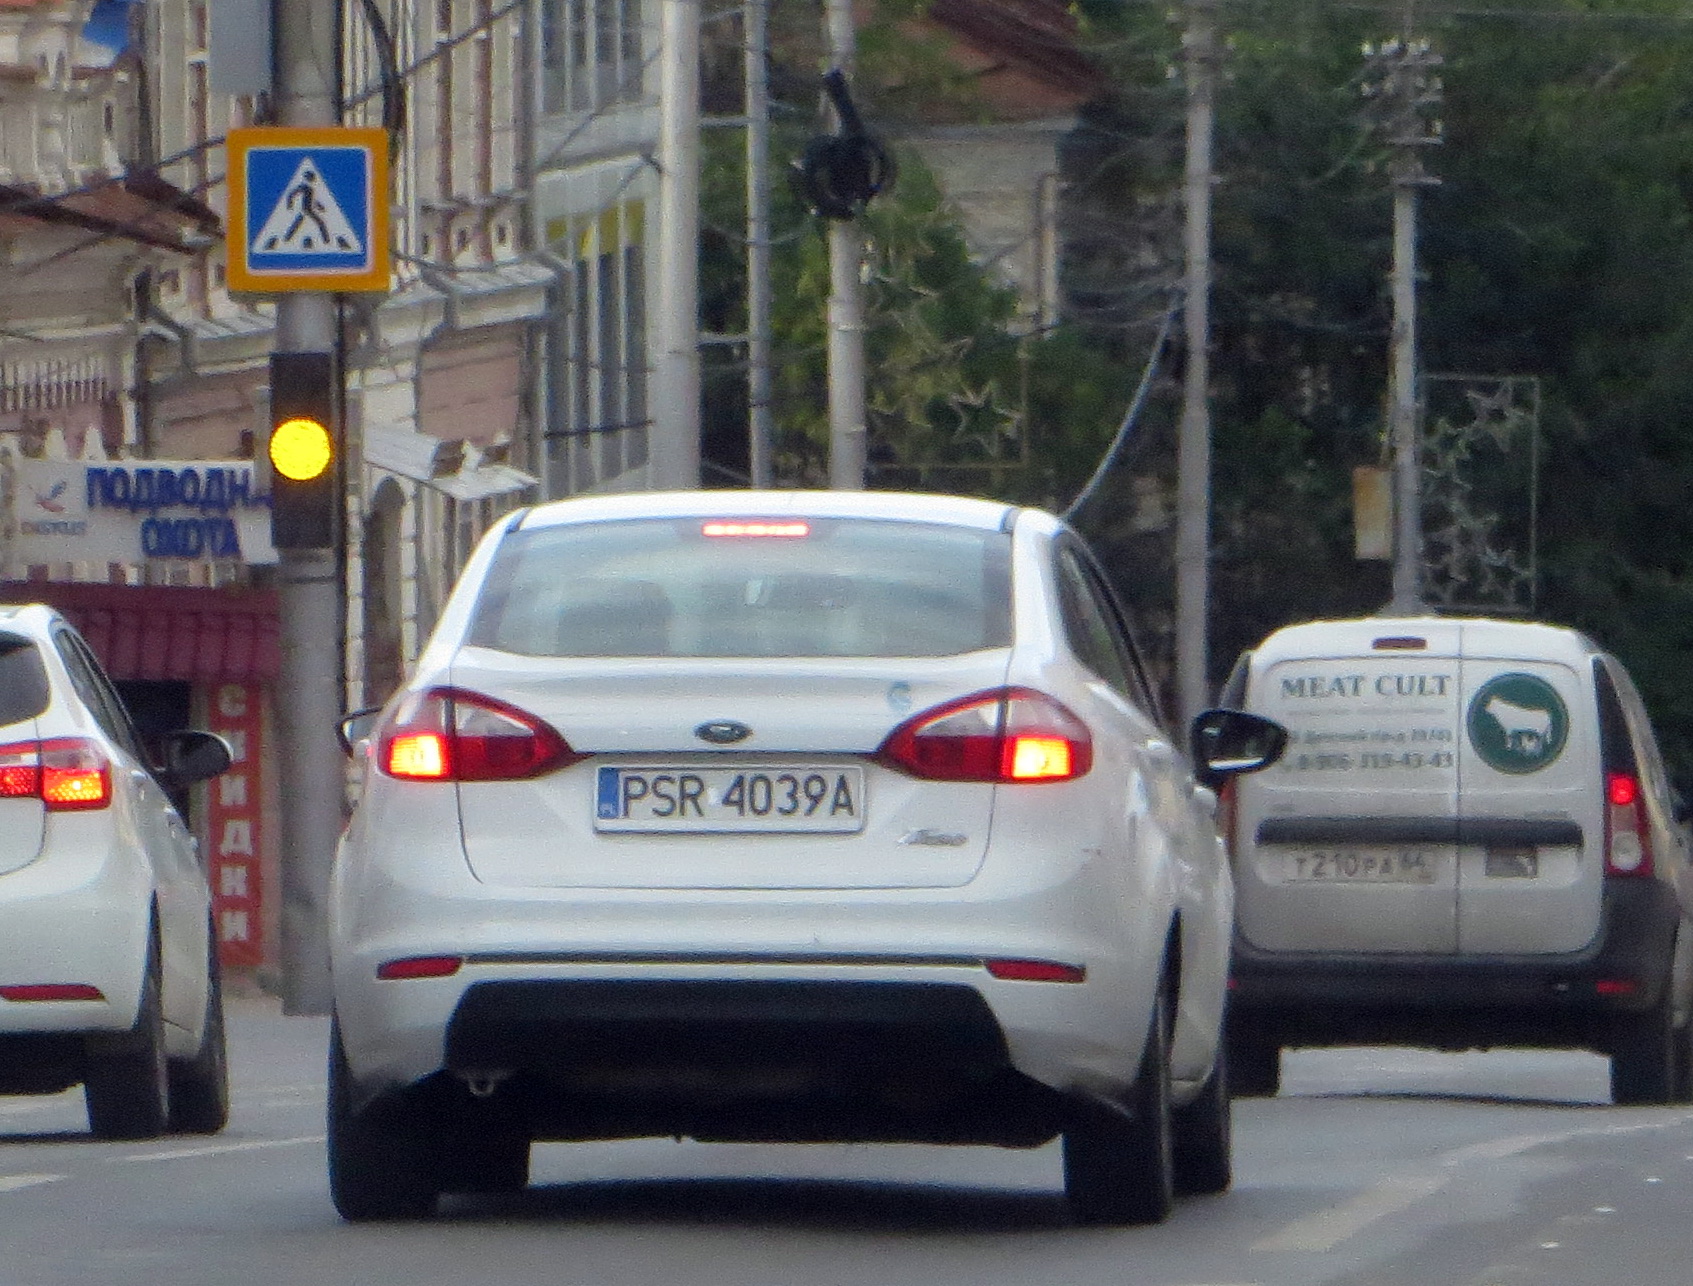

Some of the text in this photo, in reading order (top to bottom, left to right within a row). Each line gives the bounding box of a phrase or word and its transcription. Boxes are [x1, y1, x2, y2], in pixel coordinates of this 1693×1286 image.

[141, 516, 241, 557] ОХОТА
[1280, 675, 1450, 698] MEAT CULT
[623, 773, 855, 817] PSR 4039A
